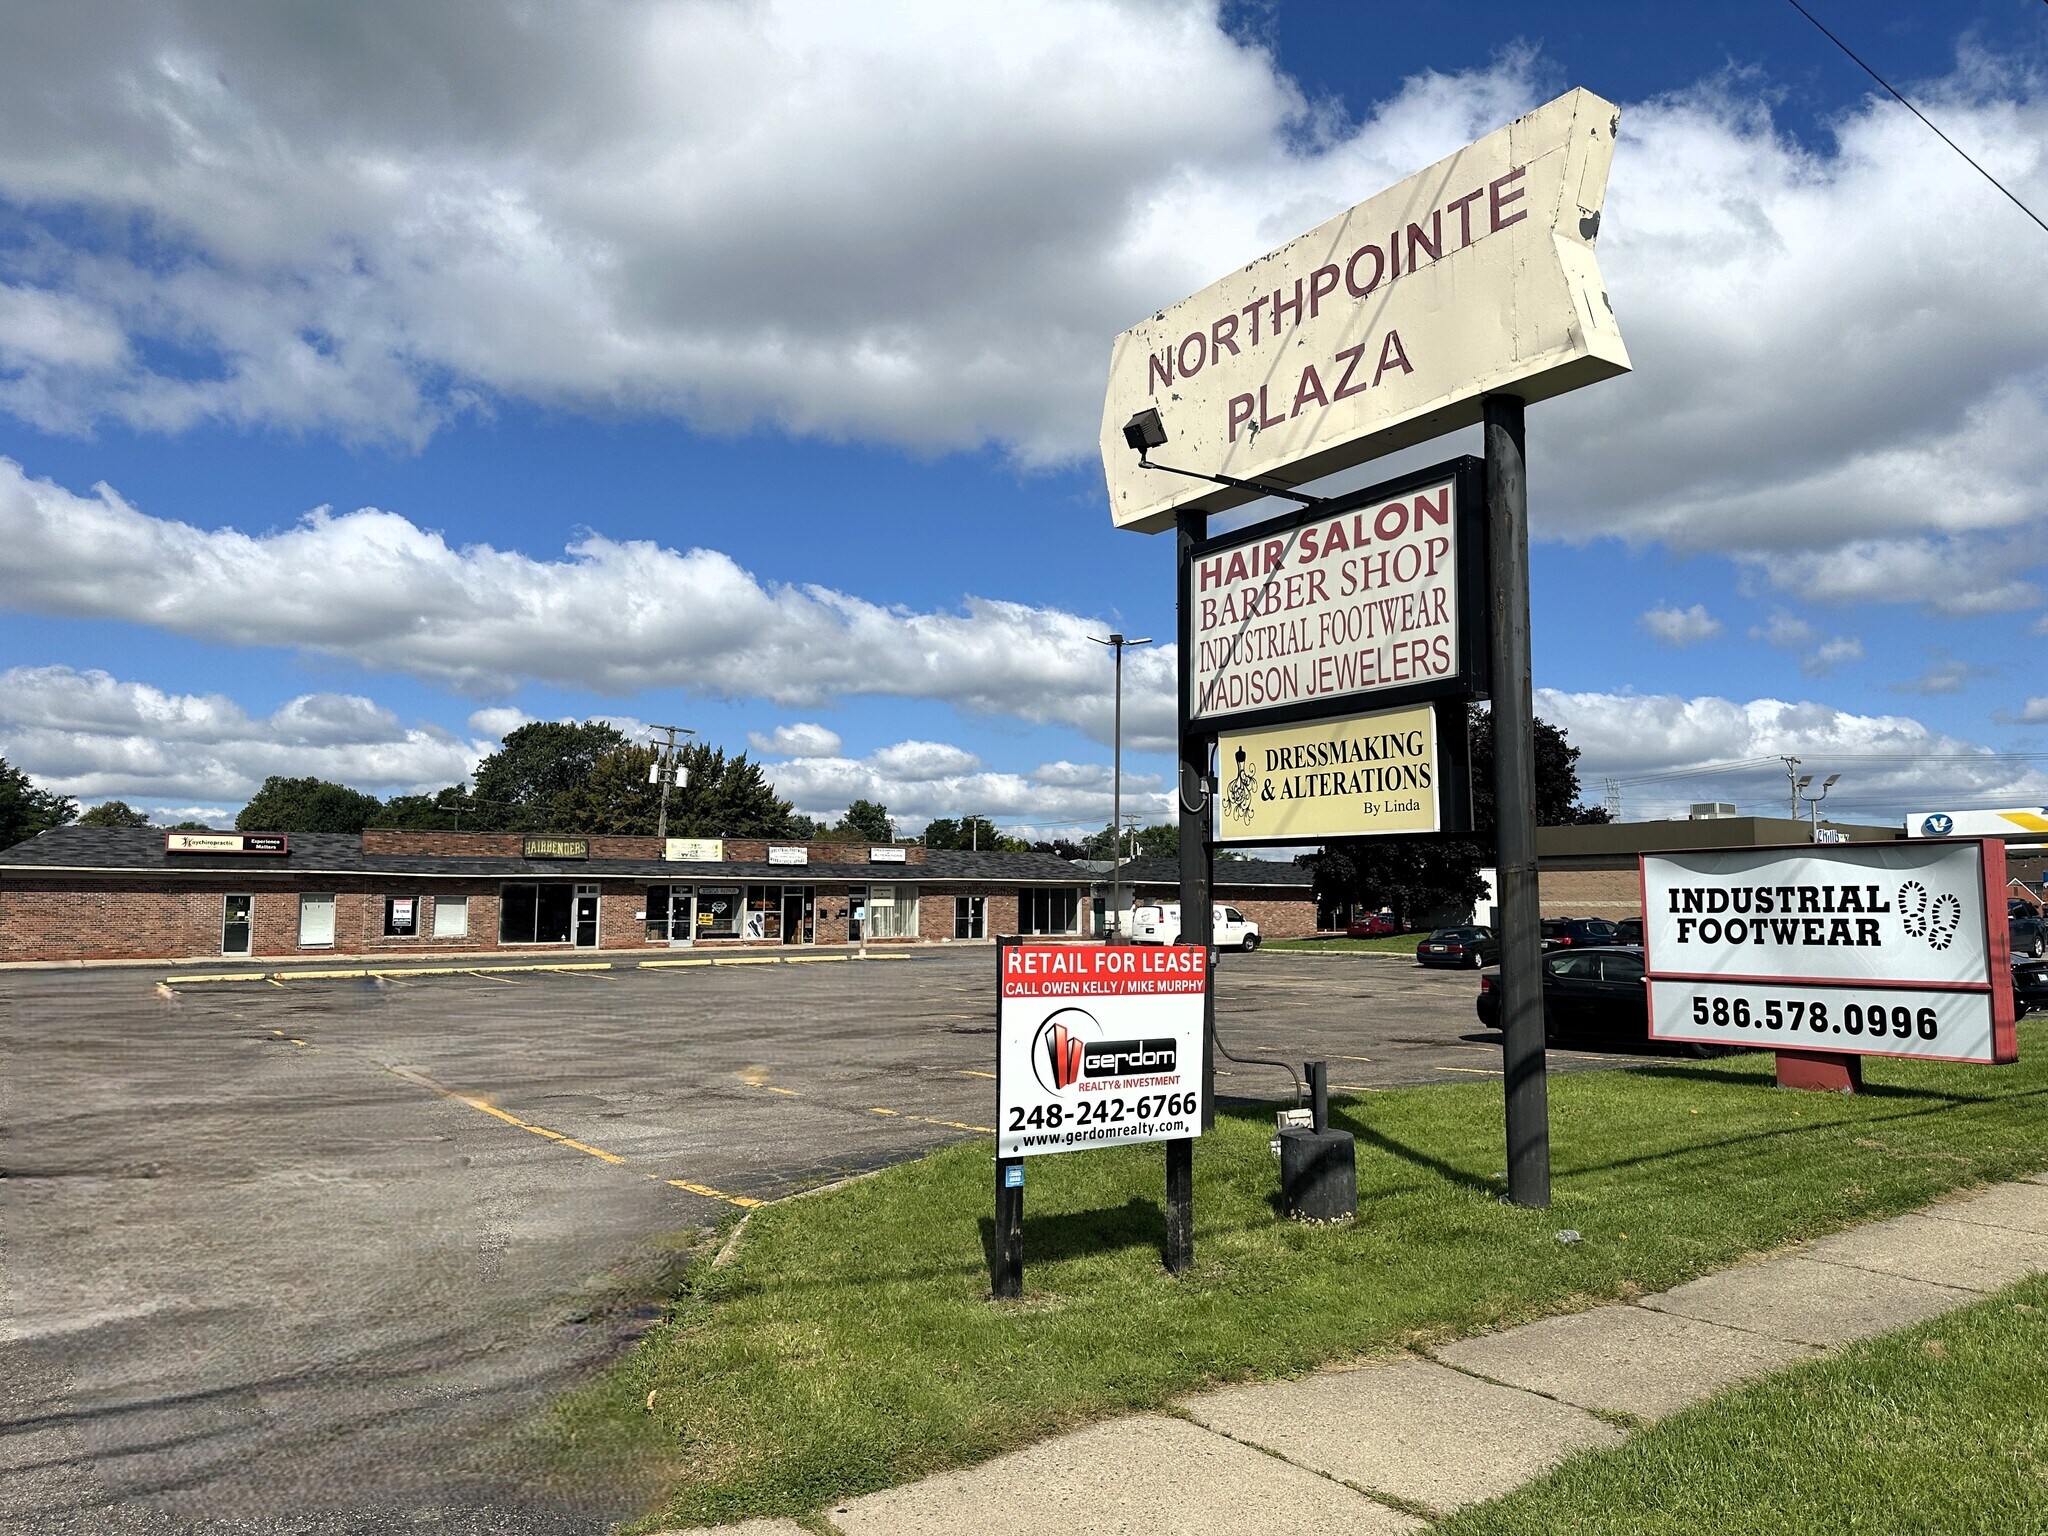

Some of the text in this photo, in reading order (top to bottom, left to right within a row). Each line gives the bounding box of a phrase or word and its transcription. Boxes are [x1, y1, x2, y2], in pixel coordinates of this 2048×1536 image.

[1148, 166, 1528, 396] NORTHPOINTE
[1228, 329, 1414, 443] PLAZA
[1200, 487, 1449, 593] HAIR SALON
[1200, 536, 1449, 632] BARBER SHOP
[1199, 586, 1450, 674] INDUSTRIAL FOOTWEAR
[1199, 634, 1450, 712] MADISON JEWELERS
[1265, 730, 1424, 772] DRESSMAKING
[1260, 762, 1432, 802] & ALTERATIONS
[1363, 799, 1421, 816] By Linda
[525, 840, 586, 856] HAIRBENDERS
[1668, 884, 1891, 914] INDUSTRIAL
[1677, 918, 1882, 947] FOOTWEAR
[1007, 952, 1204, 974] RETAIL FOR LEASE
[1005, 979, 1204, 995] CALL OWEN KELLY / MIKE MURPHY
[1692, 996, 1939, 1041] 586.578.0996
[1123, 1075, 1181, 1089] INVESTMENT
[1008, 1091, 1197, 1132] 248-242-6766
[1023, 1119, 1184, 1147] www.gerdomrealty.com
